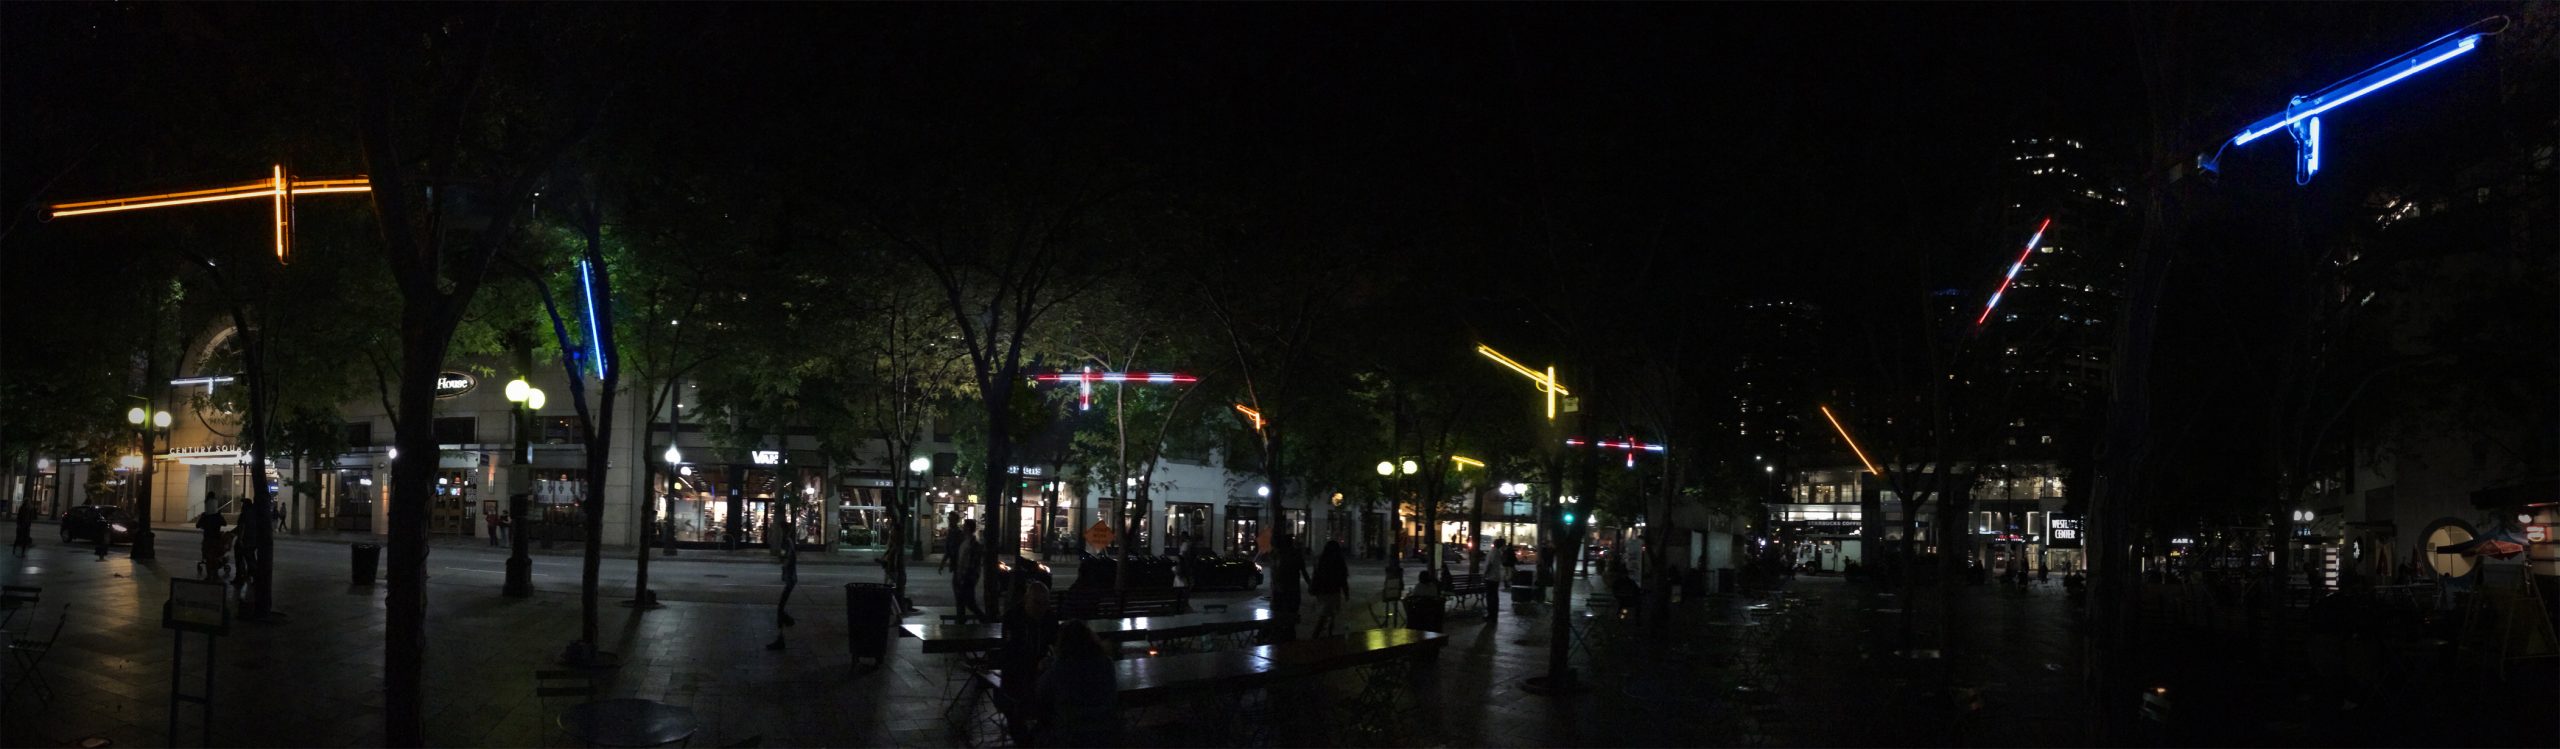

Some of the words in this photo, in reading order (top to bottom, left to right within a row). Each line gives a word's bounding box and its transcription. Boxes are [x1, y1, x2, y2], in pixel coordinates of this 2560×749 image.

[437, 377, 468, 390] House
[169, 445, 212, 454] CENTURY
[2055, 529, 2076, 539] CENTER
